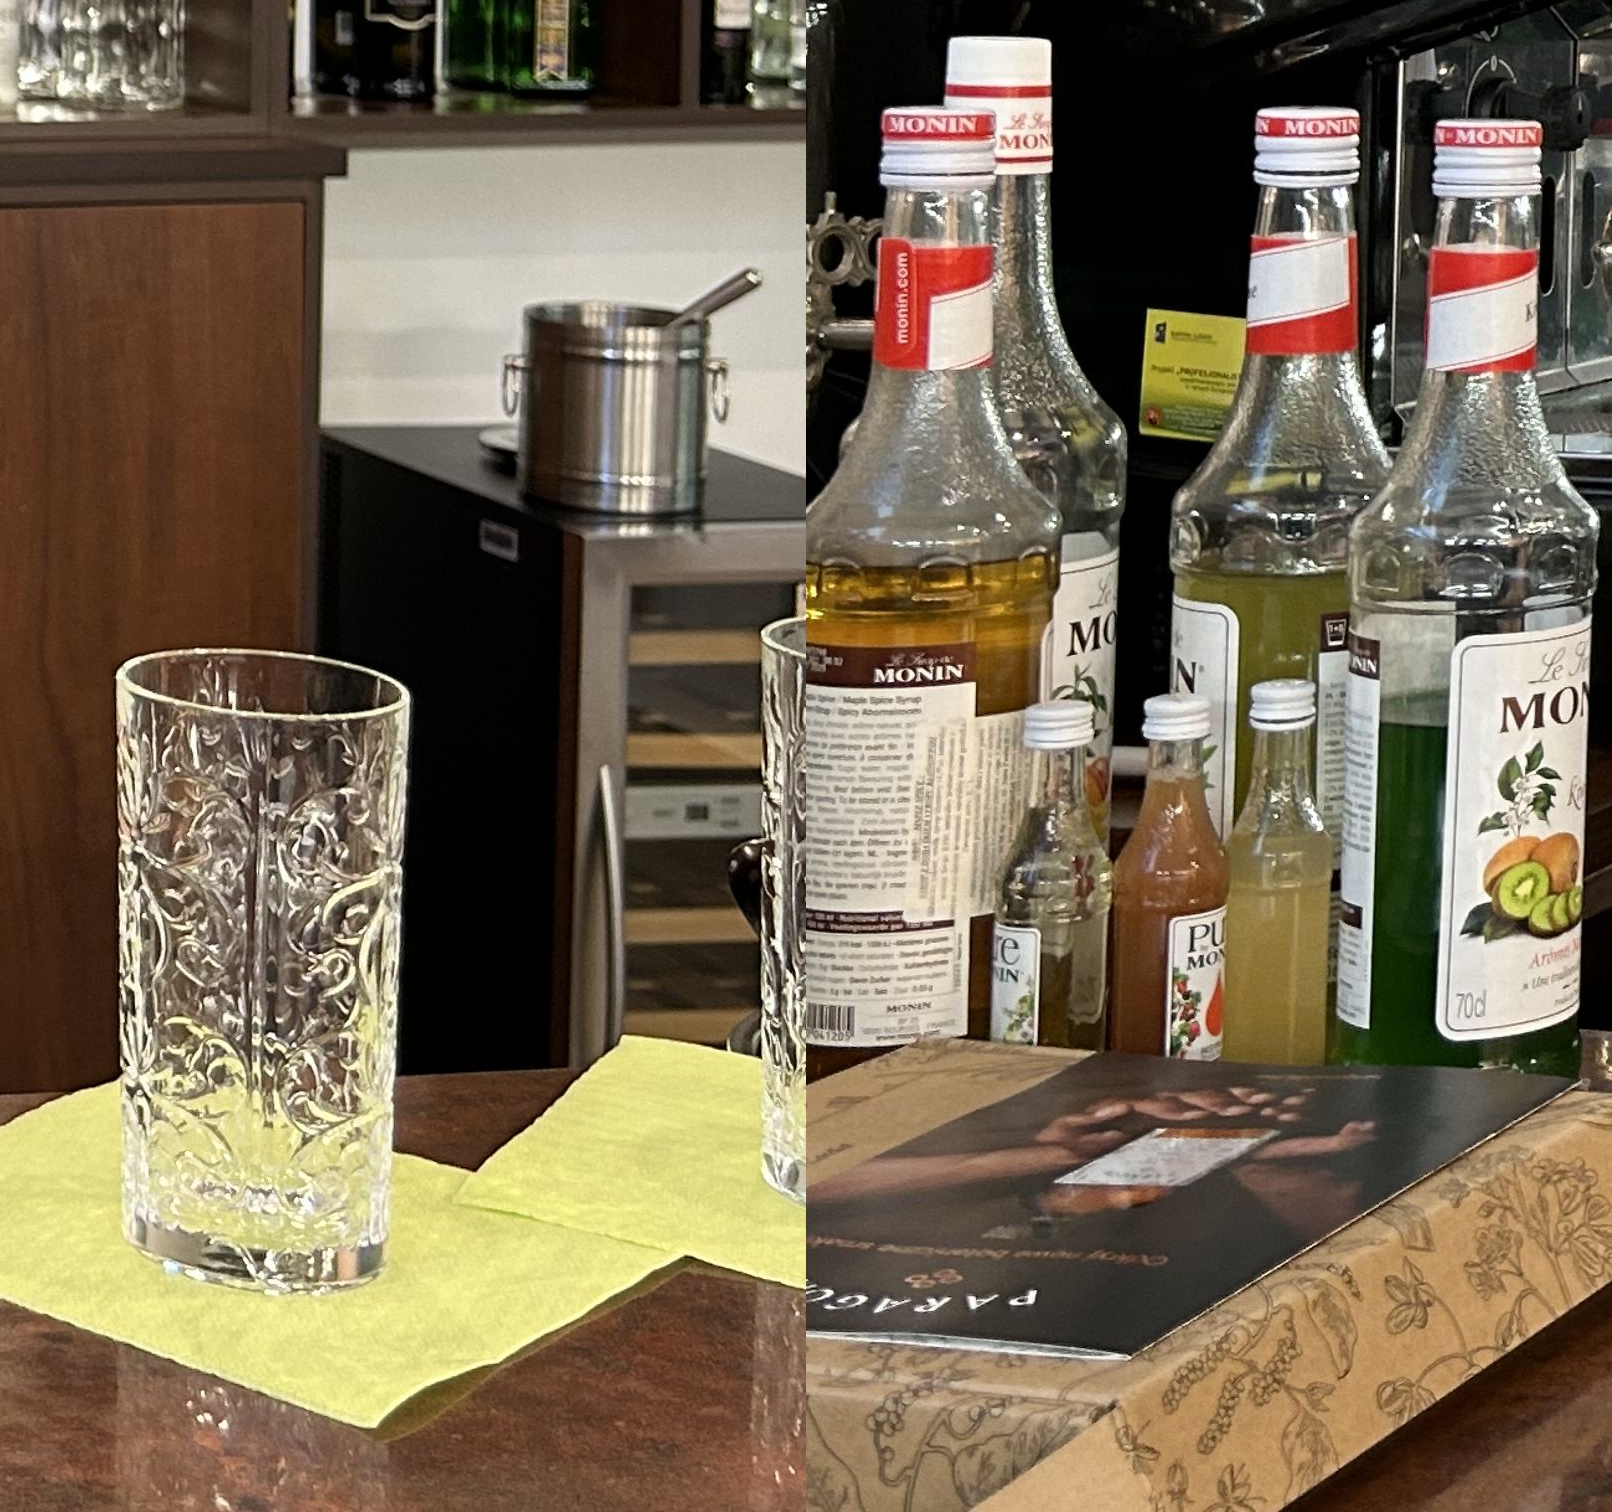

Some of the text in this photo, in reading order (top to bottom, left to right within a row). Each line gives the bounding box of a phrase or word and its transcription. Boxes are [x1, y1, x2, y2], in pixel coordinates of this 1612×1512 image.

[889, 117, 977, 133] MONIN
[1285, 118, 1358, 136] MONIN
[1456, 128, 1537, 144] MONIN
[896, 252, 909, 344] monin.com
[874, 665, 964, 683] MONIN
[1528, 646, 1566, 684] Le
[886, 1002, 932, 1014] MONIN
[1456, 990, 1487, 1019] 70cl
